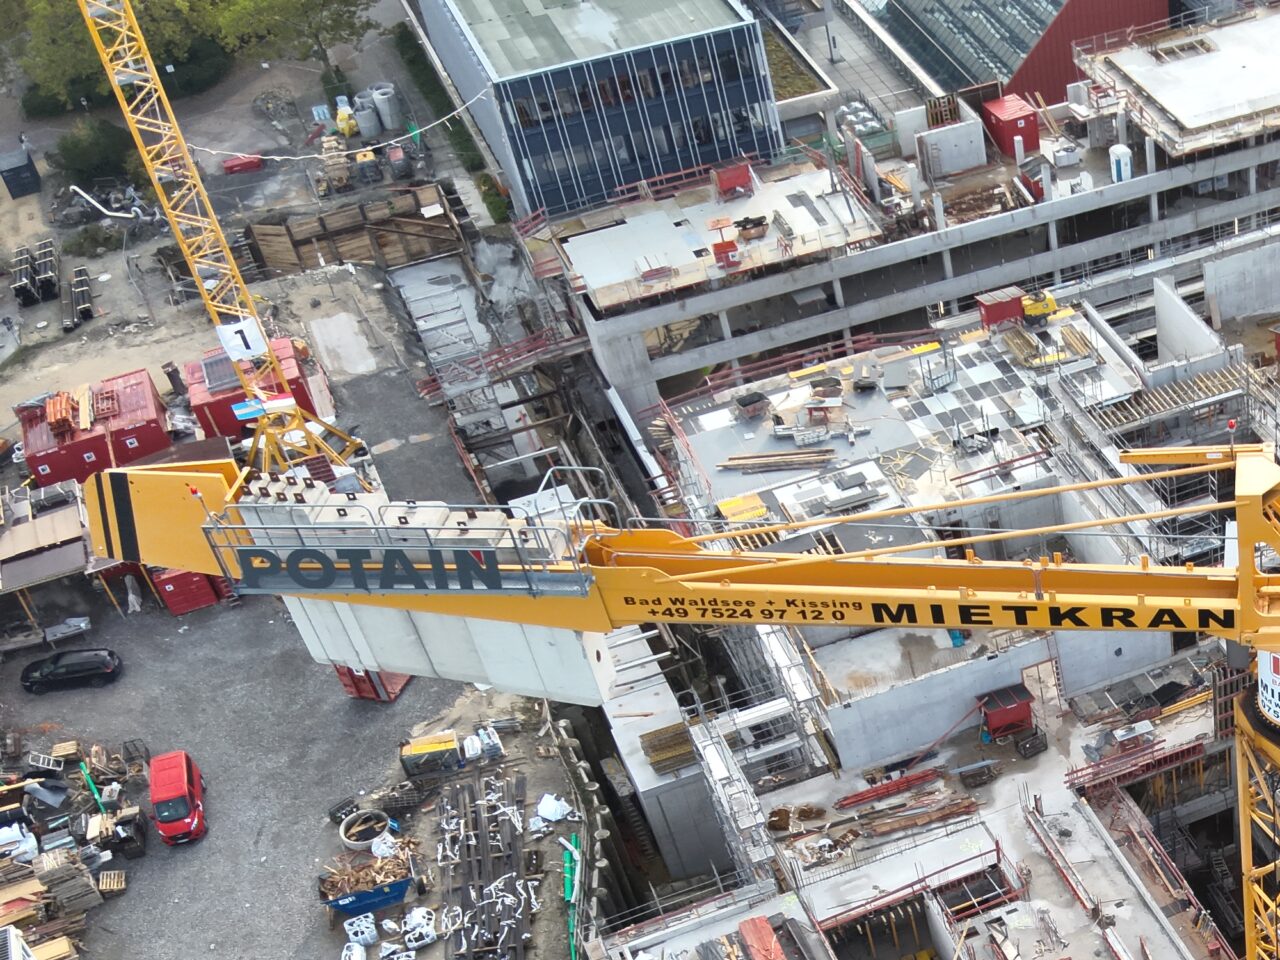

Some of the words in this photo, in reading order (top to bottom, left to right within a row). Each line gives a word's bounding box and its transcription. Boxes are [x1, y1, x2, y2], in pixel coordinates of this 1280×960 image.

[234, 329, 251, 350] 1
[236, 549, 502, 591] POTAIN
[624, 597, 662, 606] Bad
[669, 597, 755, 608] Waldsee
[786, 599, 863, 610] Kissing
[648, 608, 688, 618] +49
[697, 608, 753, 619] 7524
[761, 609, 788, 619] 97
[796, 610, 824, 620] 12
[832, 610, 845, 621] 0
[871, 603, 1235, 629] MIETKRAN
